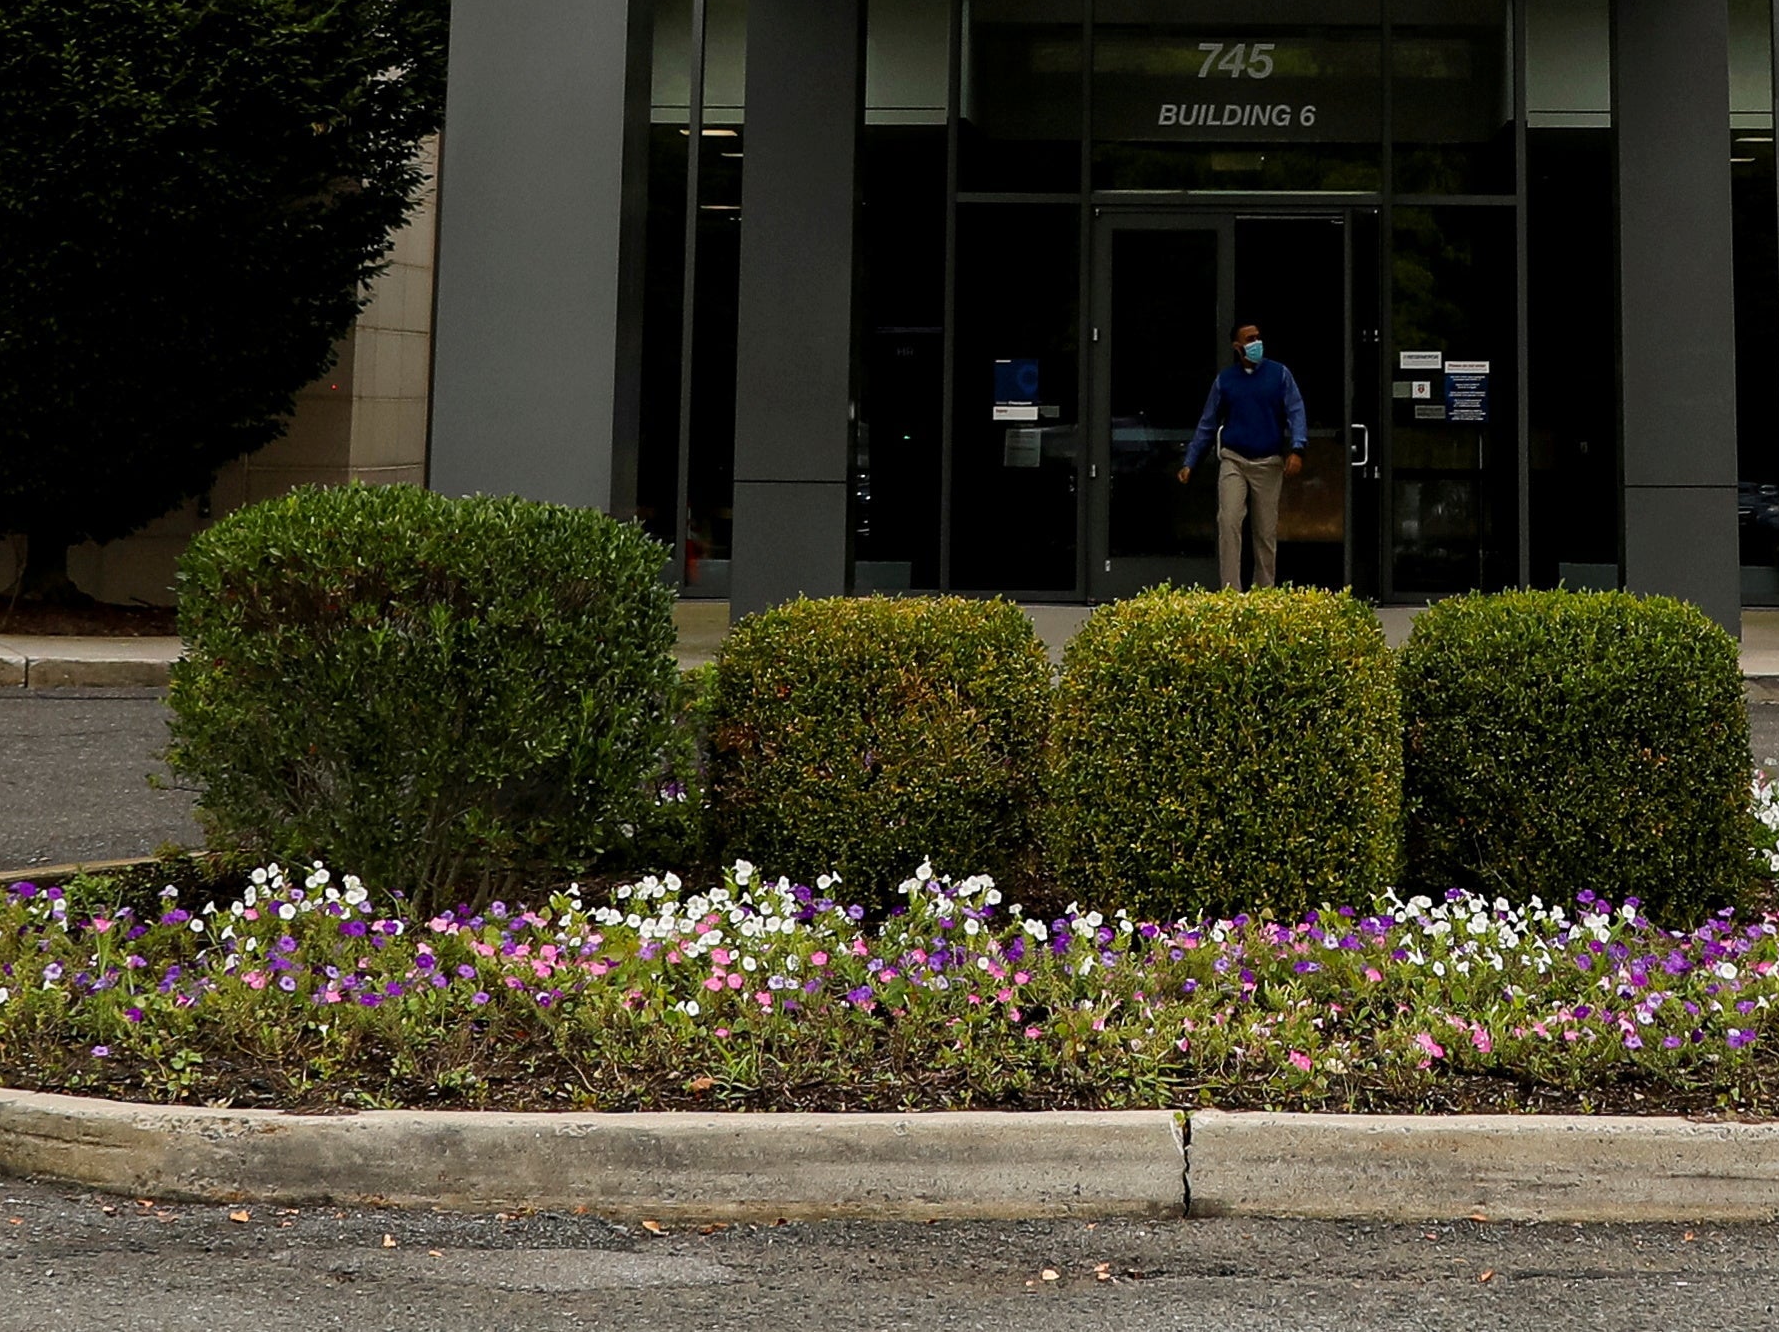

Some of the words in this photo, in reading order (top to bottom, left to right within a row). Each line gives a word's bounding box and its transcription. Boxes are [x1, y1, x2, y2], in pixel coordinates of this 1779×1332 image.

[1198, 43, 1275, 79] 745
[1158, 104, 1291, 126] BUILDING
[1300, 105, 1316, 127] 6
